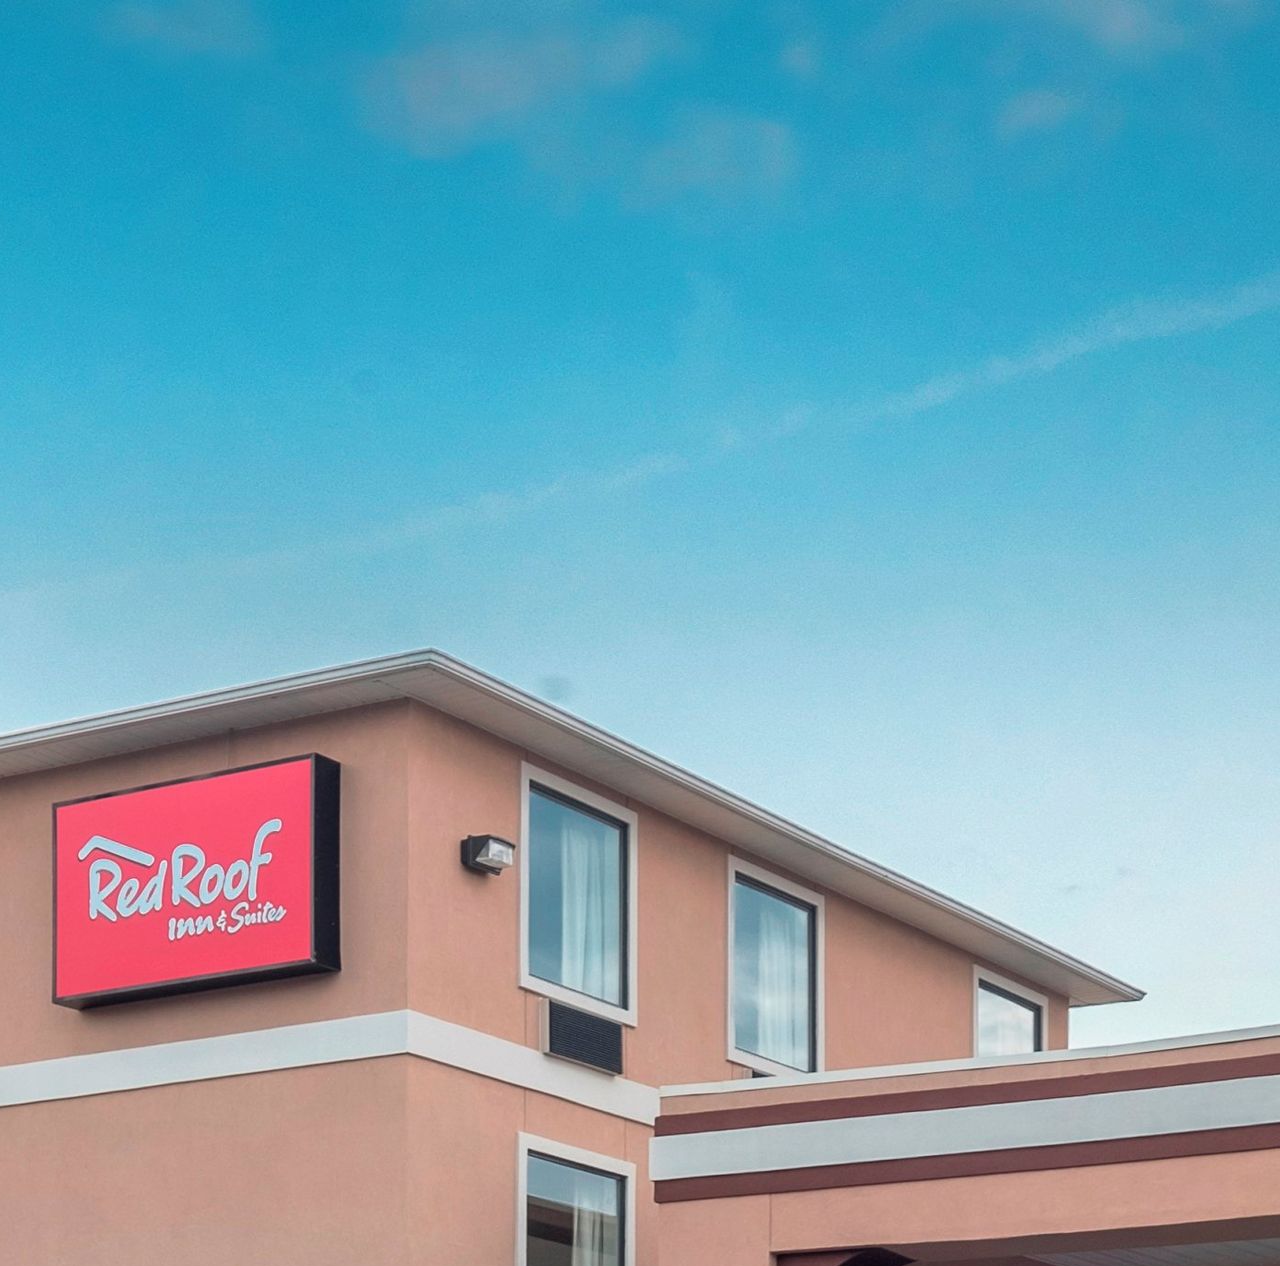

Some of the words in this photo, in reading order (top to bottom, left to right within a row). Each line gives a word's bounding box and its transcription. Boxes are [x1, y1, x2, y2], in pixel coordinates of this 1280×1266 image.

[89, 858, 168, 922] Red
[171, 818, 282, 908] Roof
[168, 917, 215, 941] Inn
[216, 909, 227, 932] &
[227, 901, 287, 933] Suites
